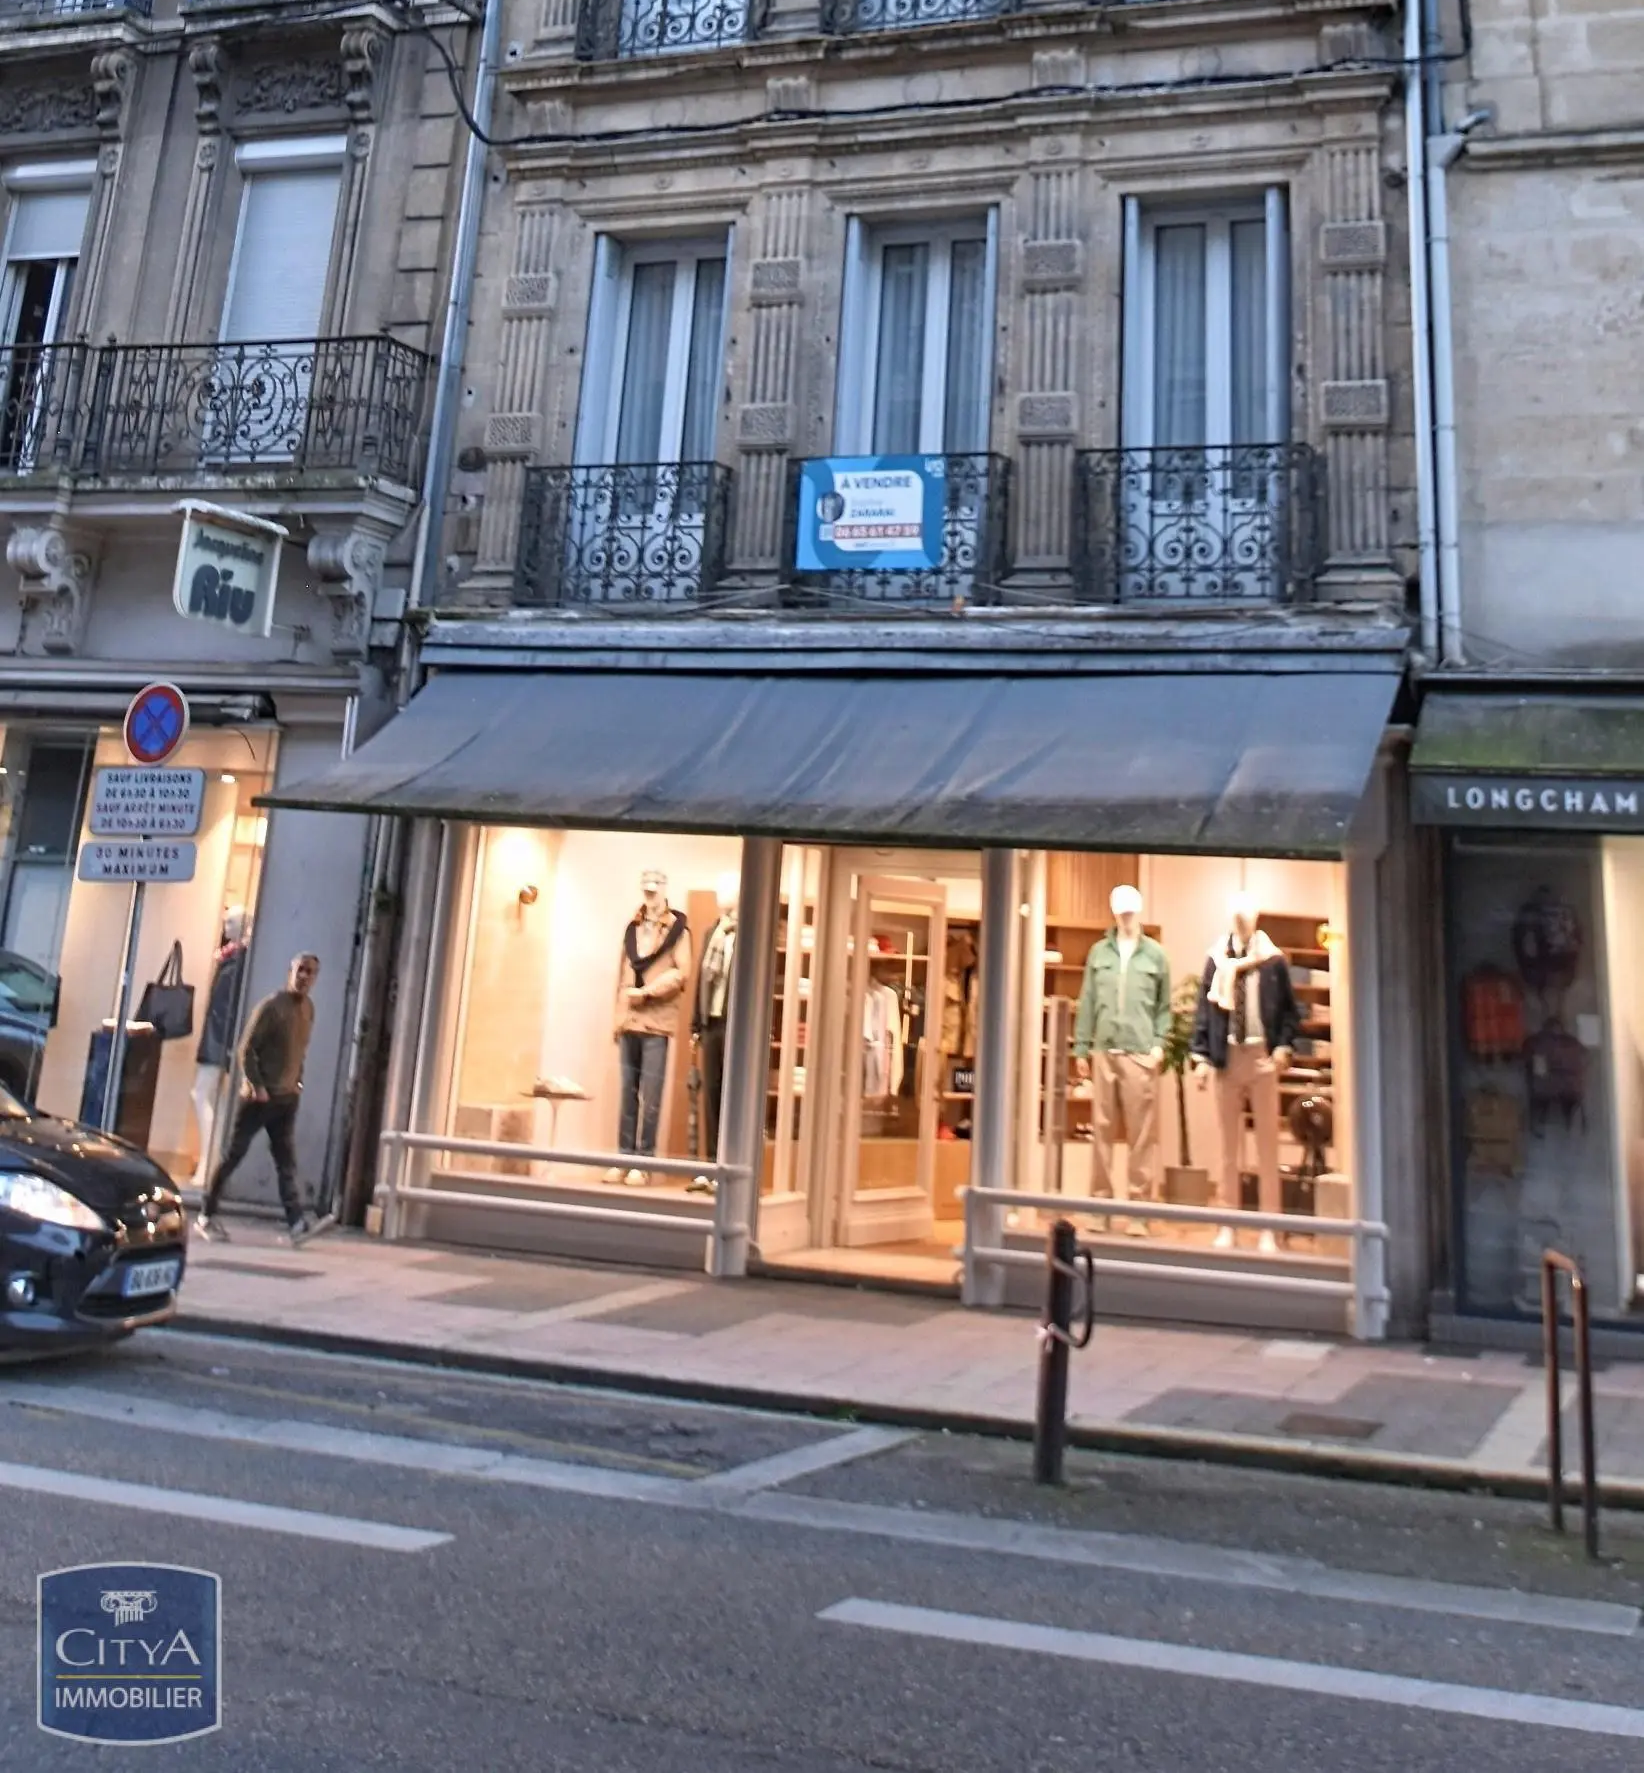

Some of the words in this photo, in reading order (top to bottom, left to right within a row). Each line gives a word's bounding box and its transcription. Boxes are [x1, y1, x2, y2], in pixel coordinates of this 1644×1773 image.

[854, 475, 913, 489] VENDRE
[188, 564, 255, 624] Riu
[107, 772, 132, 784] SAUF
[134, 772, 193, 784] LIVRAISONS
[105, 787, 118, 799] DE
[96, 803, 121, 814] SAUF
[158, 803, 196, 815] MINUTE
[101, 817, 113, 829] DE
[95, 846, 112, 859] 30
[118, 847, 180, 859] MINUTES
[103, 864, 169, 876] MAXIMUM
